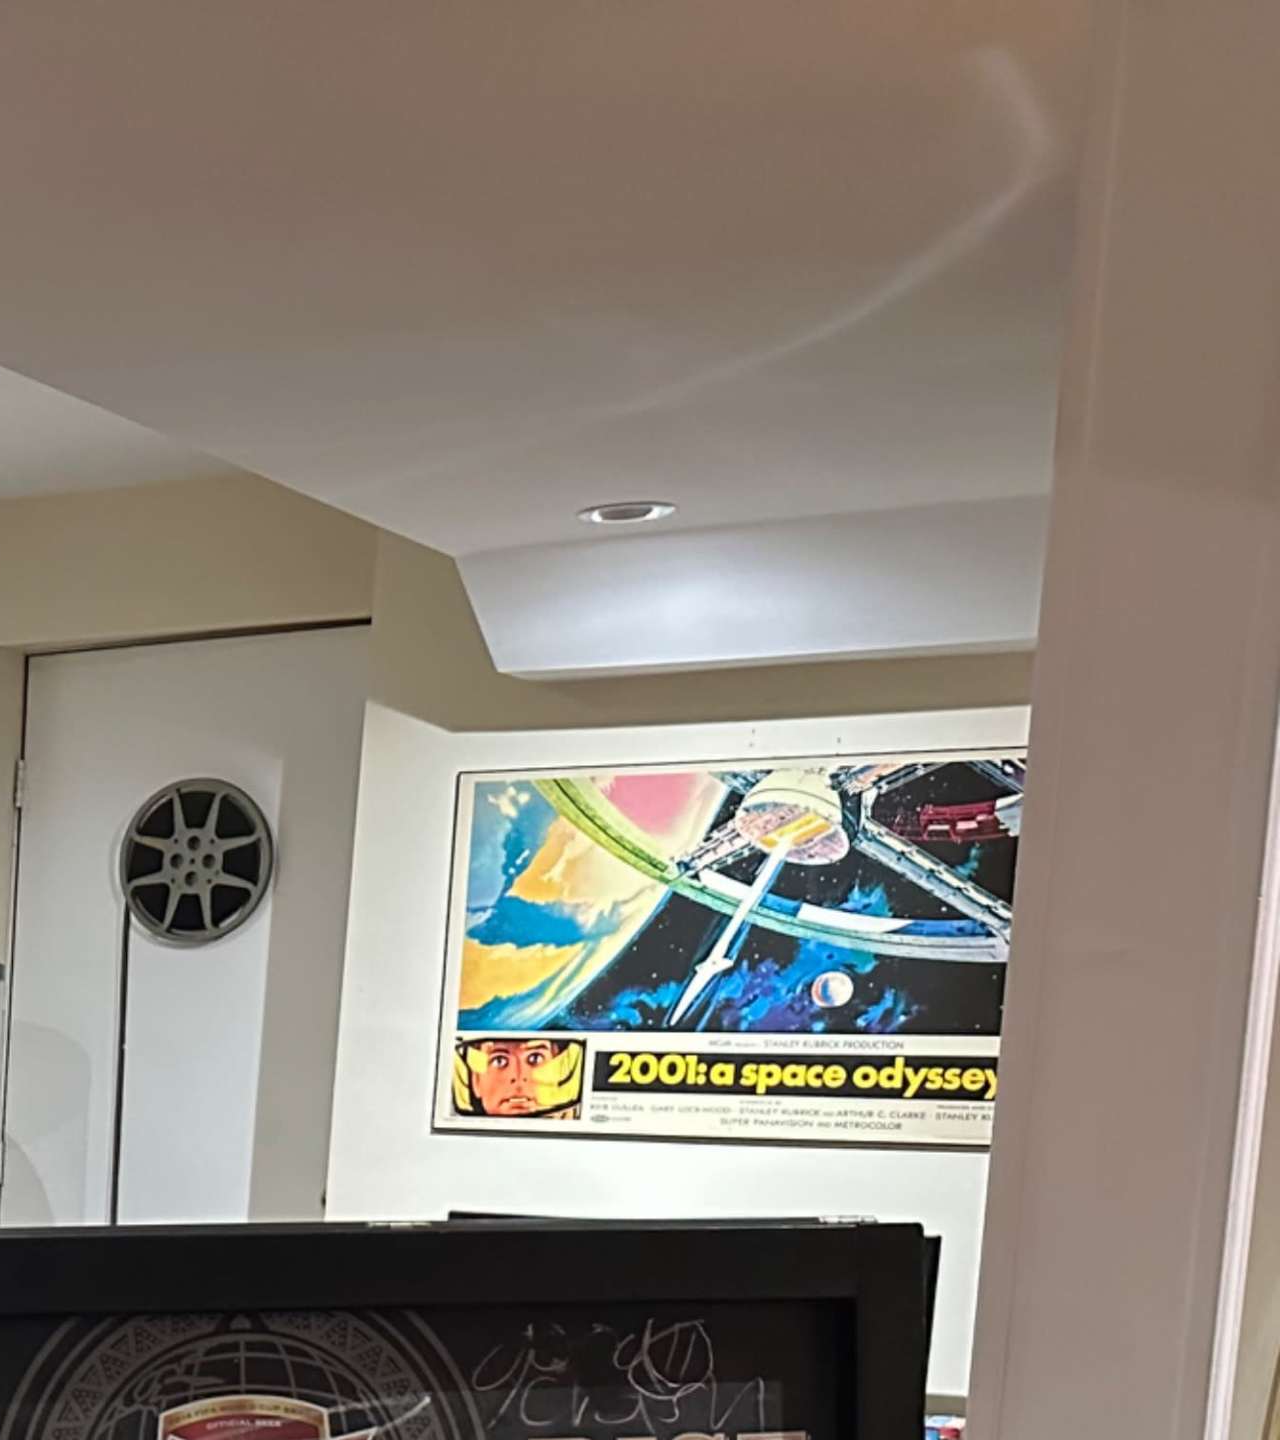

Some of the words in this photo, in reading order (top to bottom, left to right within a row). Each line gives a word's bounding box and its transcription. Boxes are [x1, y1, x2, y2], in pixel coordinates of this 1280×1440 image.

[709, 1063, 735, 1086] a
[739, 1063, 847, 1096] space
[852, 1057, 998, 1101] odyssey
